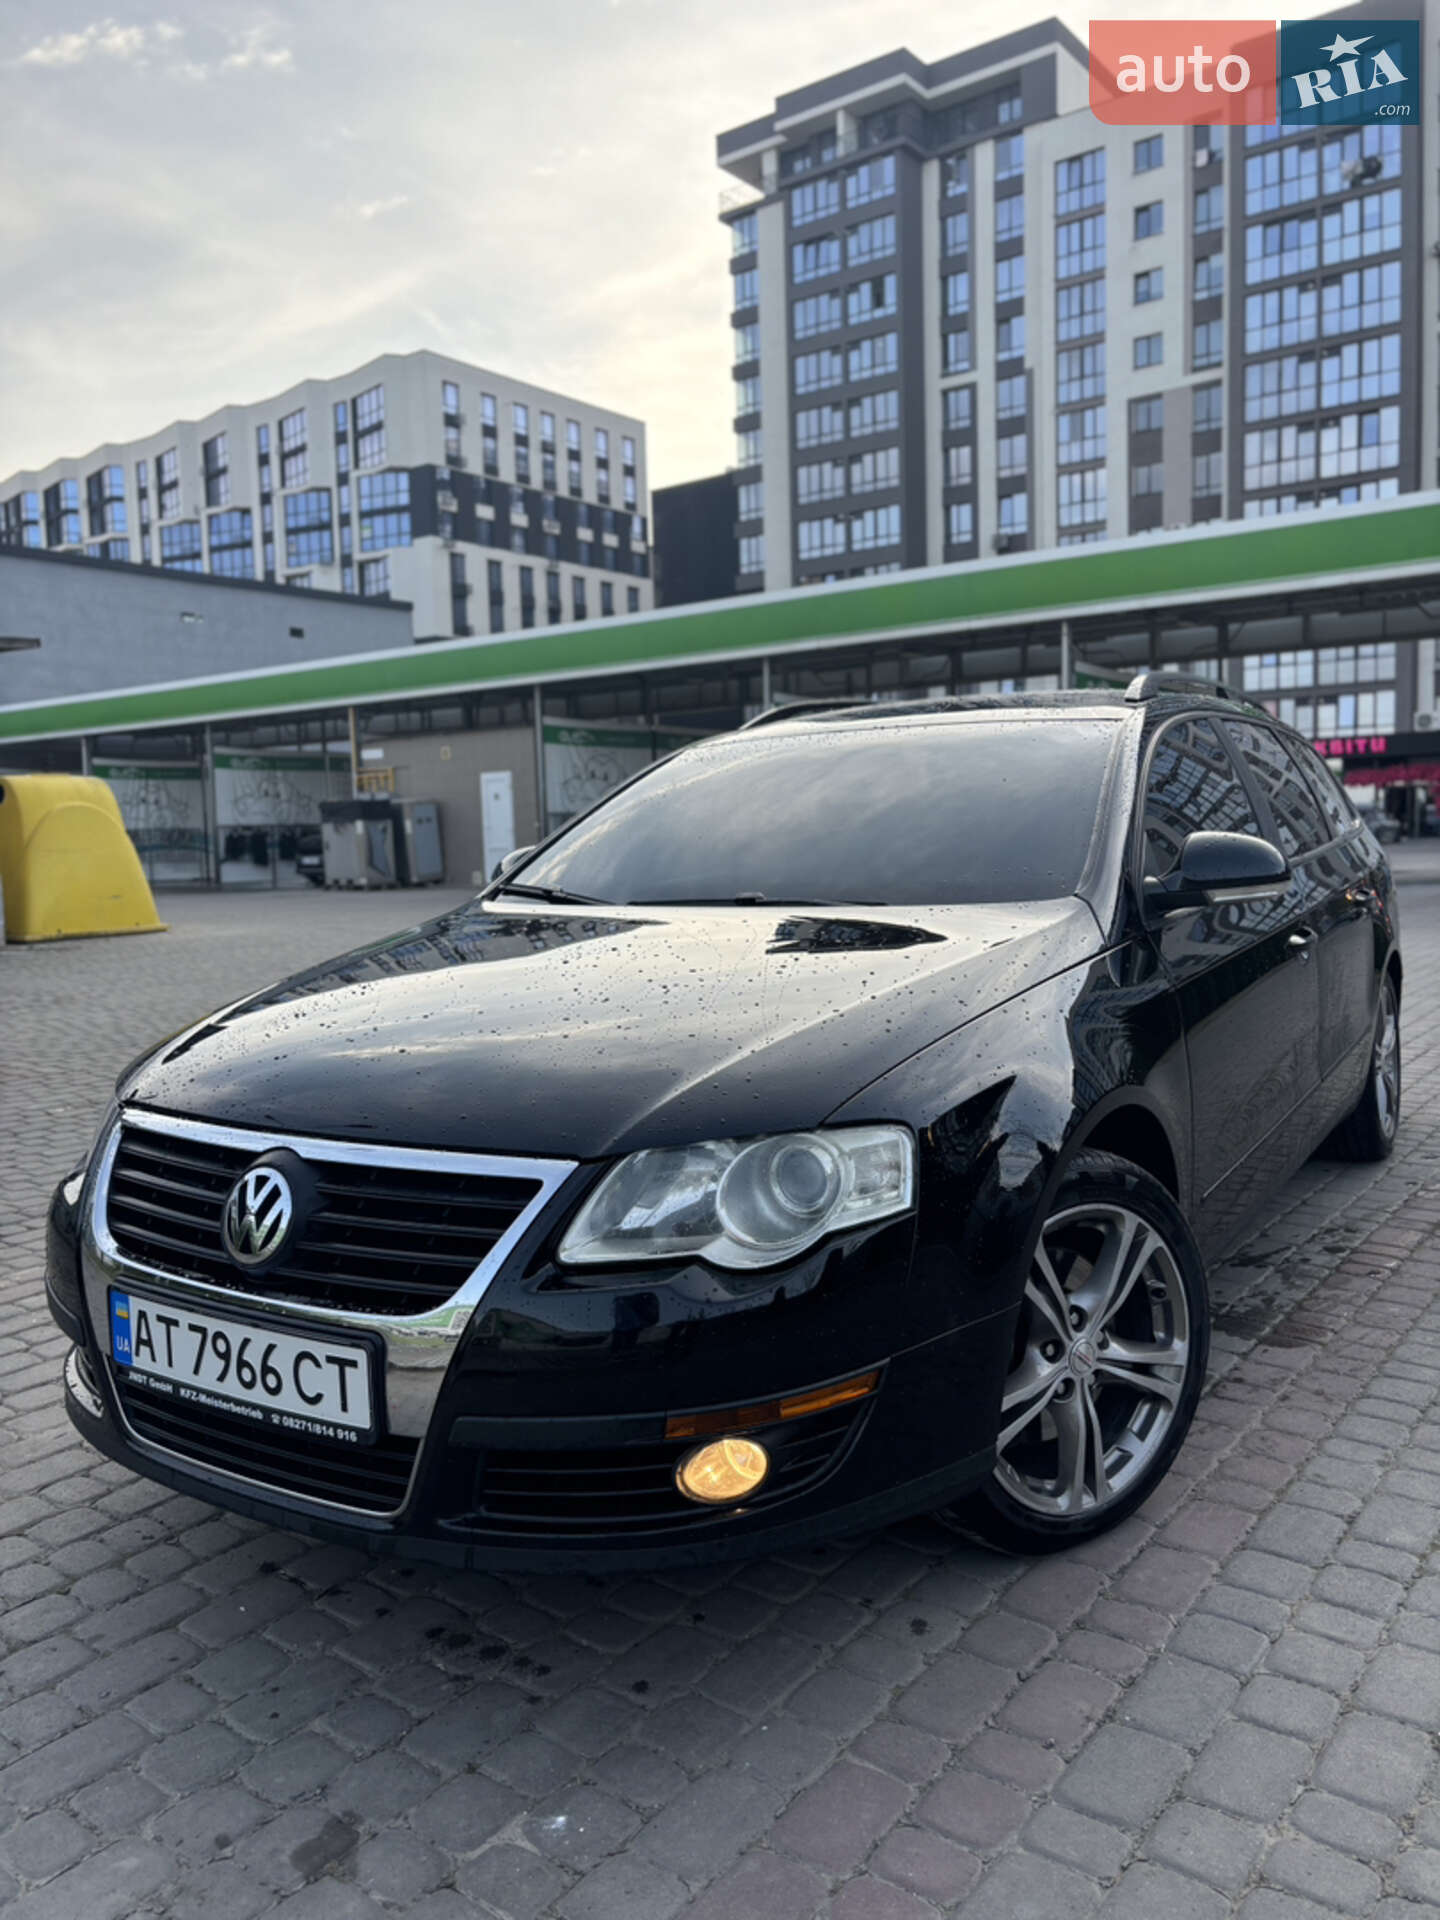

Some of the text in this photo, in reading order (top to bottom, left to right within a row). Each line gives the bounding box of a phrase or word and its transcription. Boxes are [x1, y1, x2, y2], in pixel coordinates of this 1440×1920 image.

[134, 1309, 358, 1413] AT 7966 CT
